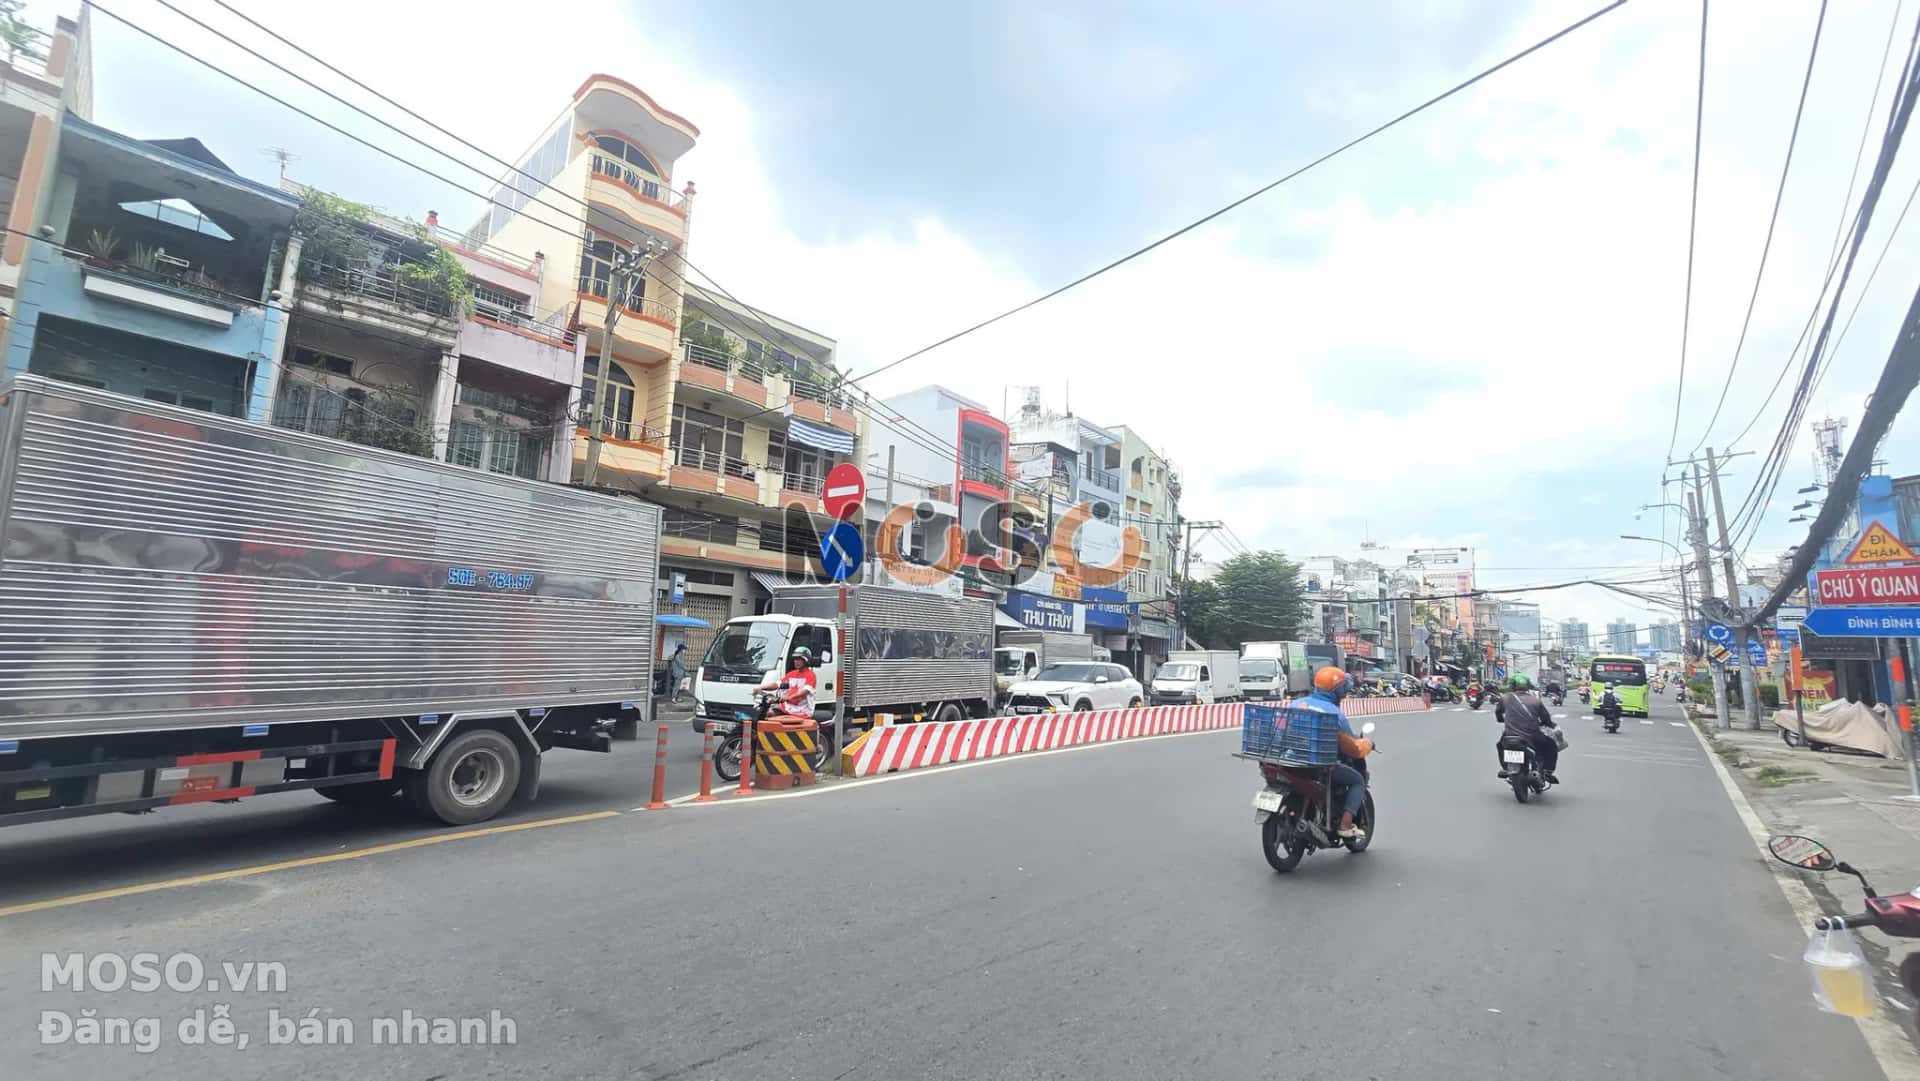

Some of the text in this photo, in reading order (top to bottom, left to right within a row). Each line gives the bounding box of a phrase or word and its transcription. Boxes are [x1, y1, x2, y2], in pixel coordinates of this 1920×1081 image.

[1870, 534, 1886, 545] ĐI
[1821, 573, 1920, 598] CHÚ Ý QUAN
[1023, 609, 1045, 626] THU
[1847, 616, 1878, 629] ĐÌNH
[1881, 616, 1913, 629] BÌNH
